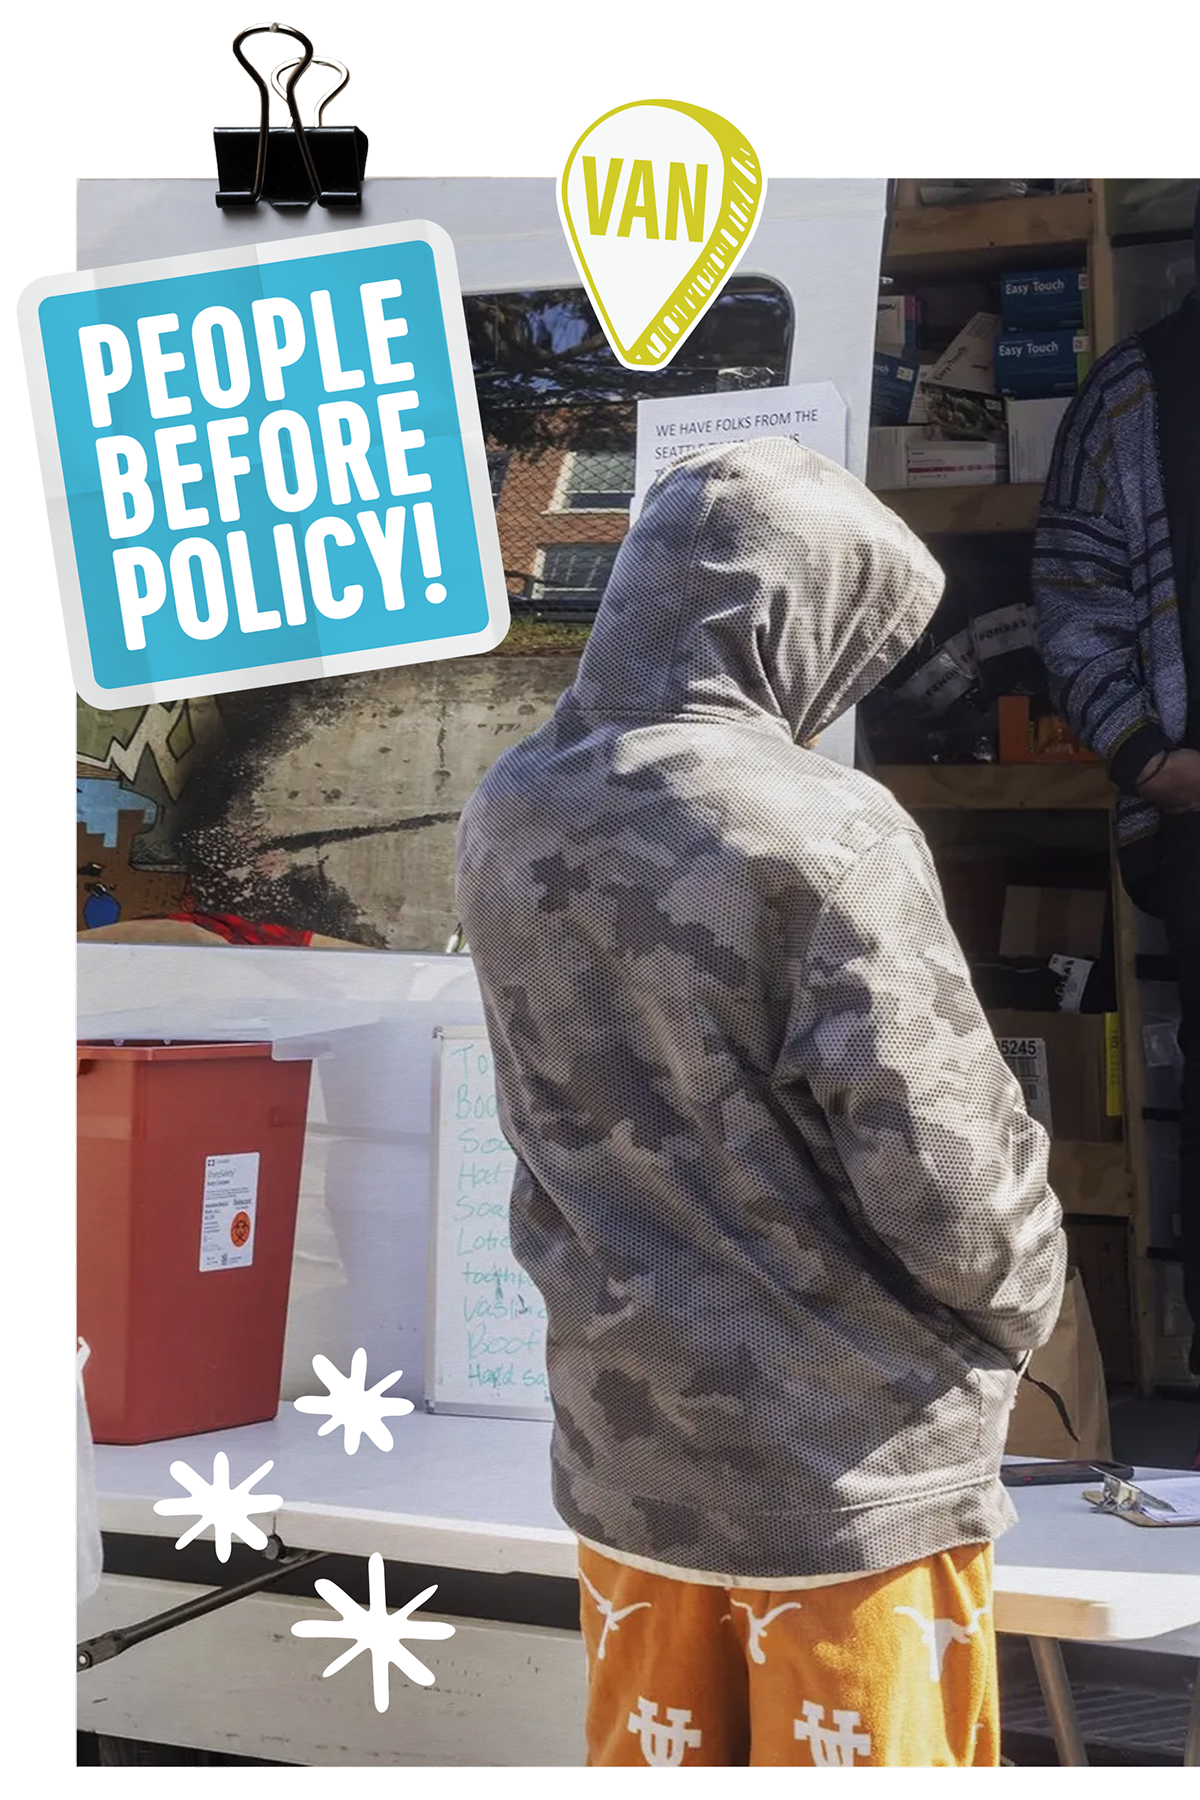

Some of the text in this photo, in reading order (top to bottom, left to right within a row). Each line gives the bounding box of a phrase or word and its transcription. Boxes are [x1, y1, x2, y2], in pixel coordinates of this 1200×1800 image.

[1005, 284, 1029, 295] Easy
[1033, 279, 1065, 291] Touch
[999, 345, 1022, 358] Easy
[1027, 341, 1059, 354] Touch
[656, 409, 818, 437] WE HAVE FOLKS FROM THE
[998, 1040, 1036, 1055] 5245
[457, 1227, 511, 1256] Lotio
[523, 1369, 549, 1387] sa
